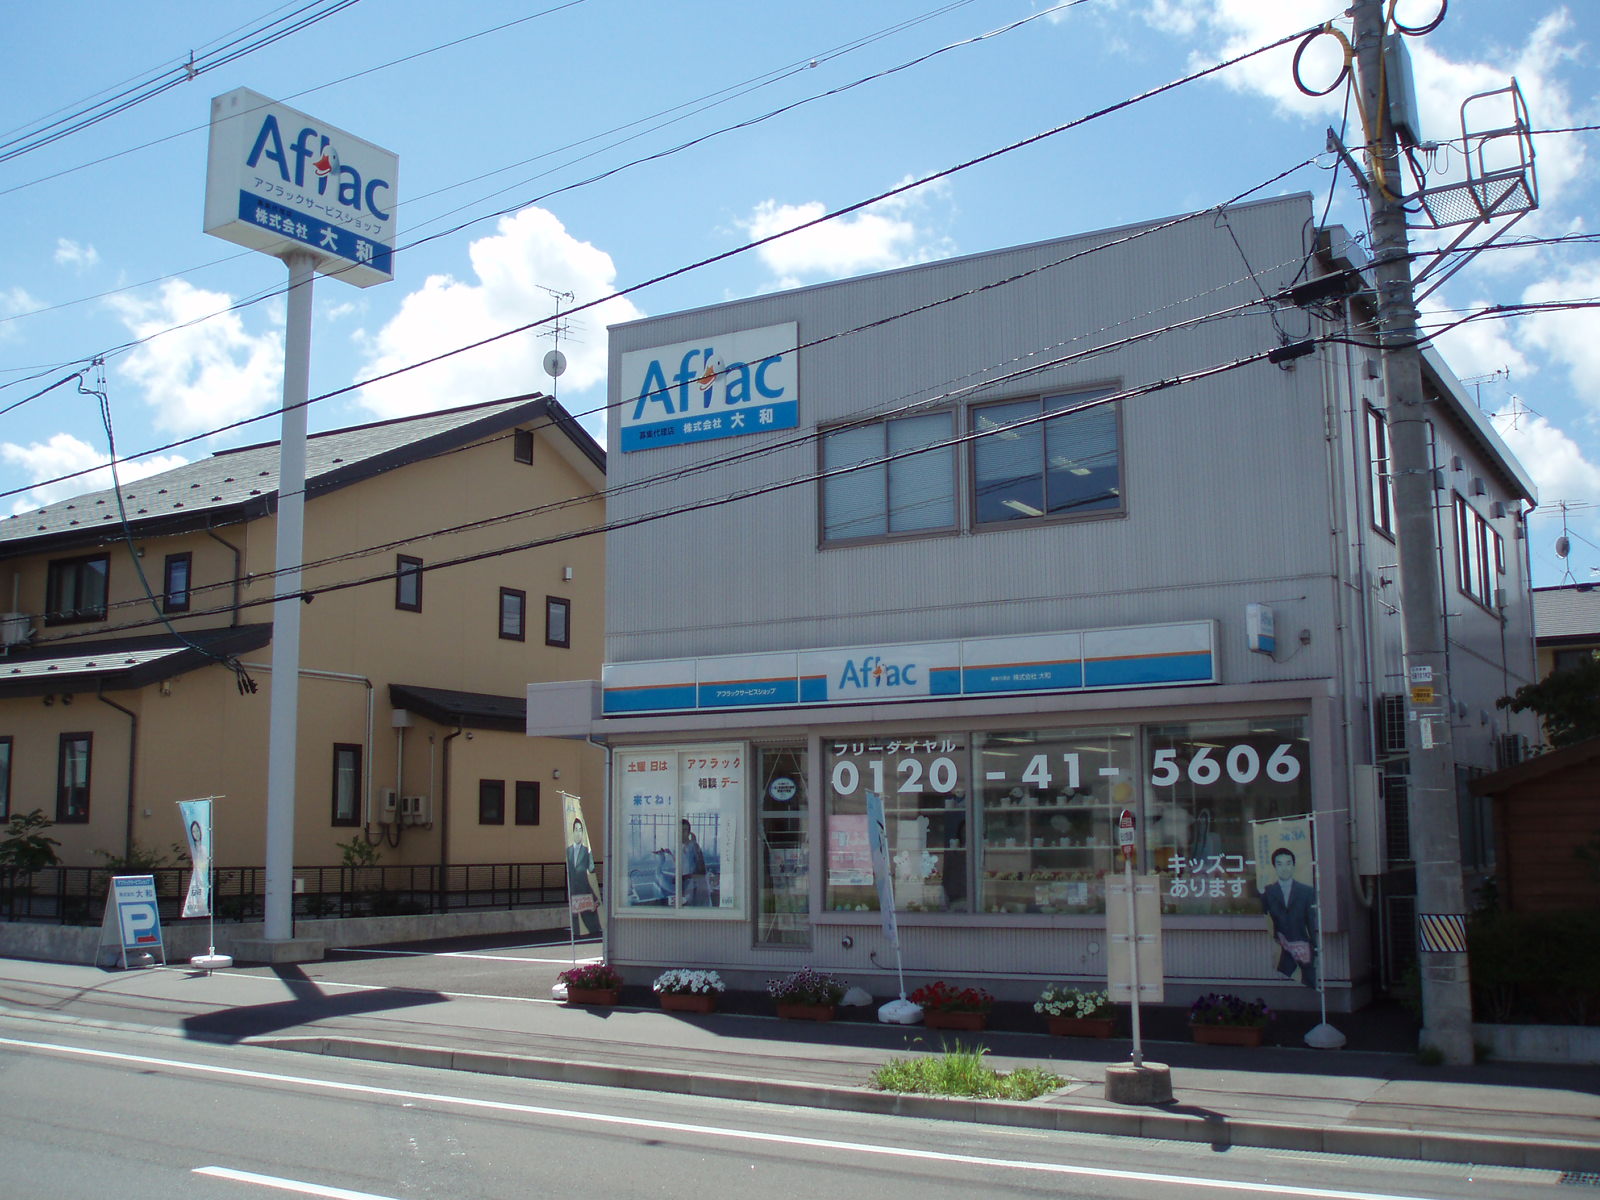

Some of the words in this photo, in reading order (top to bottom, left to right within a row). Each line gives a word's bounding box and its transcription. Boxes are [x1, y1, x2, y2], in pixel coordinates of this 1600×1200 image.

[246, 114, 390, 221] Aflac
[254, 177, 382, 235] アフラックサービスショップ
[255, 207, 308, 239] 株式会社
[632, 347, 785, 420] Aflac
[683, 418, 722, 434] 株式会社
[838, 656, 917, 689] Aflac
[687, 757, 741, 769] アフラック
[834, 739, 956, 757] フリーダイヤル
[1170, 879, 1247, 898] あります
[121, 904, 156, 945] P
